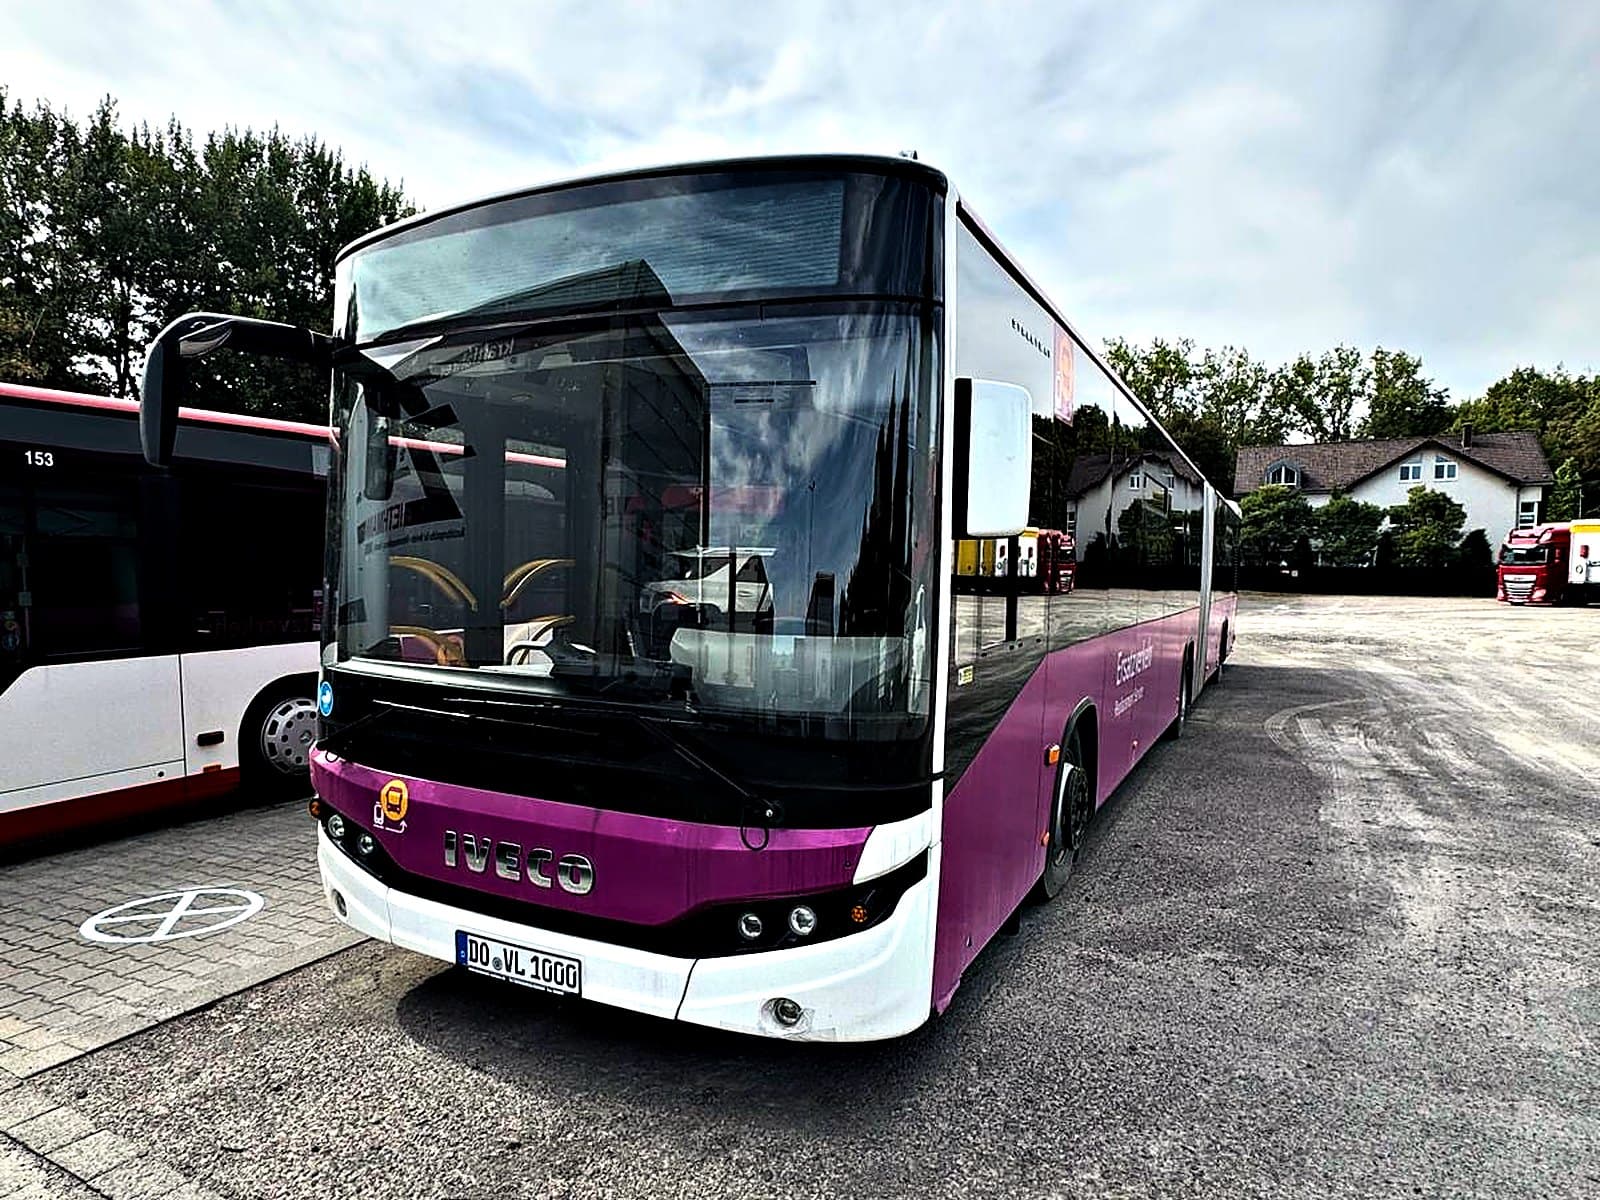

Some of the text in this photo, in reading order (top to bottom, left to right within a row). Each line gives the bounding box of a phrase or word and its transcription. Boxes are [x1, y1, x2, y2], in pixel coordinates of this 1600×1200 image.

[24, 450, 55, 468] 153
[444, 830, 594, 895] IVECO
[468, 938, 490, 967] DO
[503, 947, 526, 976] VL
[530, 955, 577, 989] 1000
